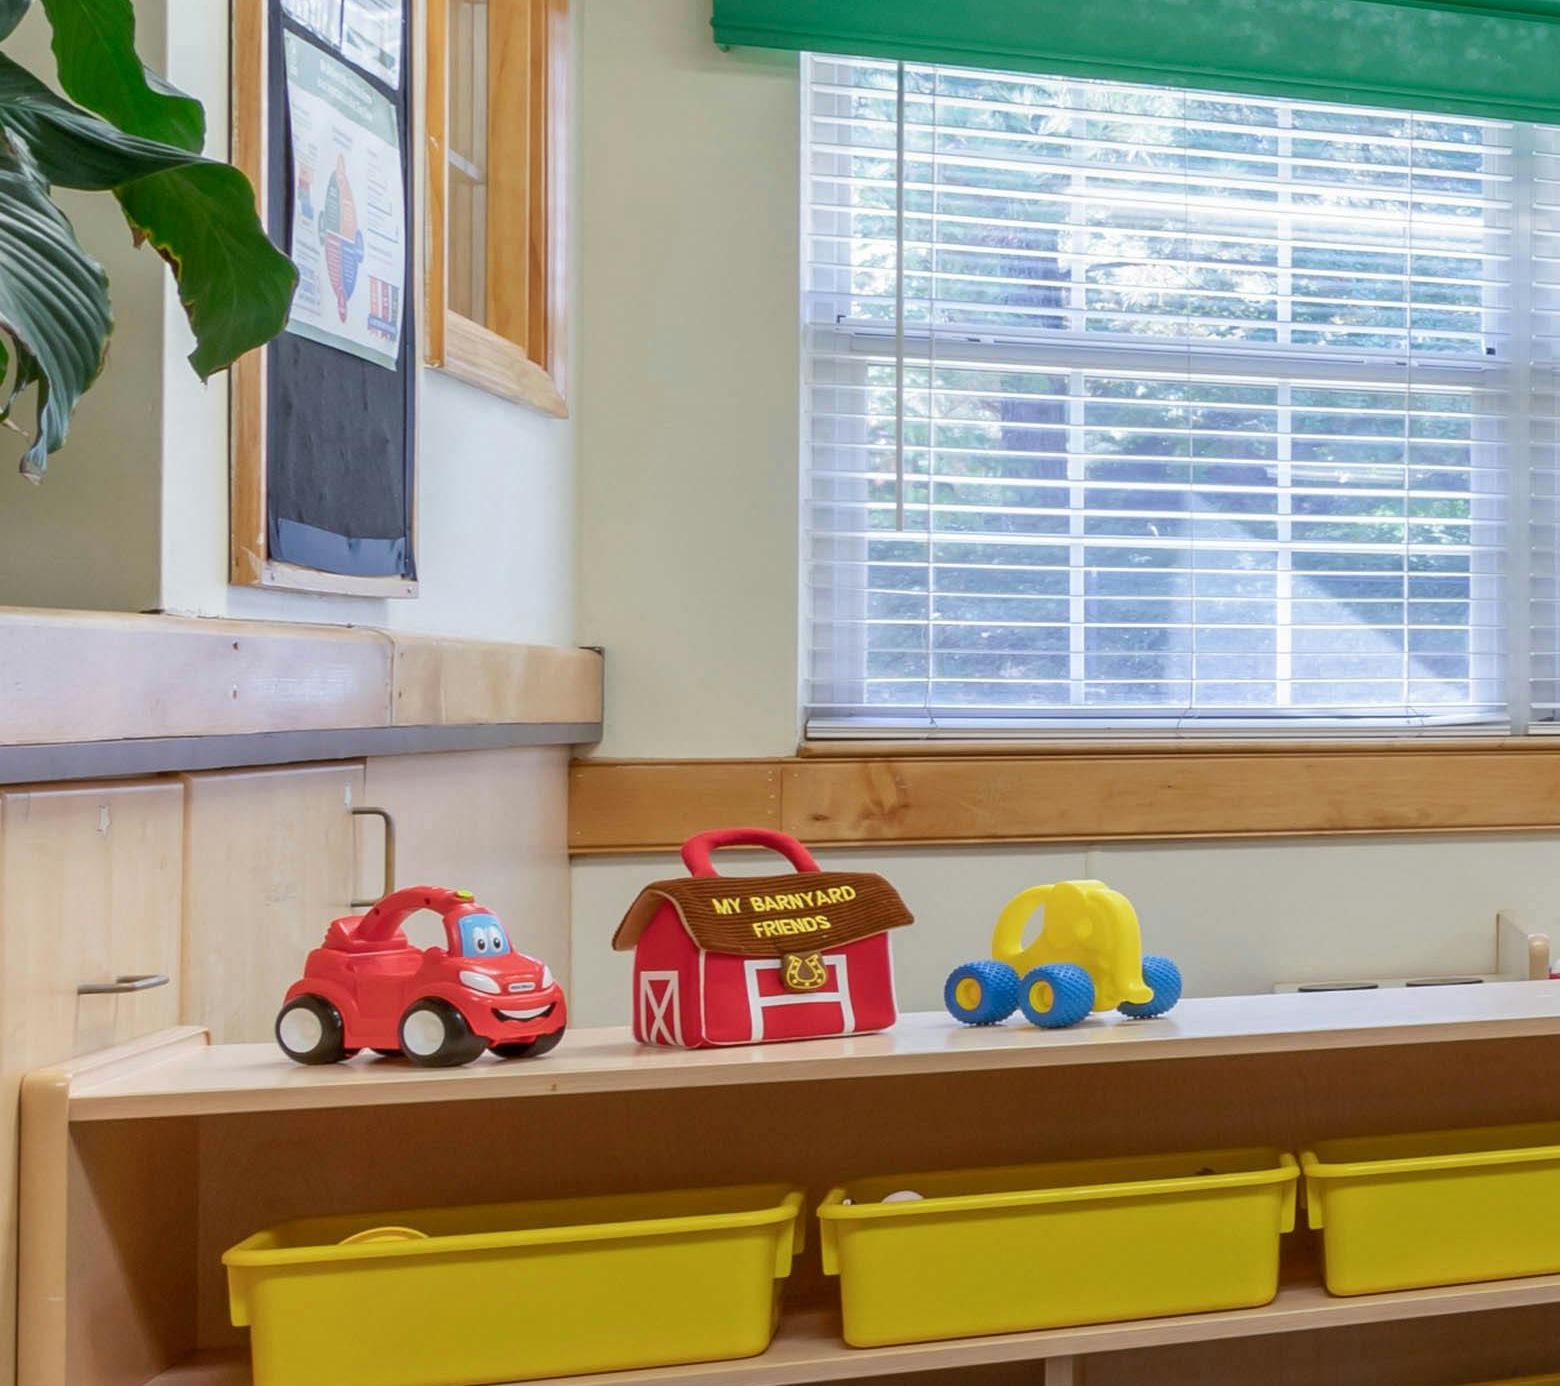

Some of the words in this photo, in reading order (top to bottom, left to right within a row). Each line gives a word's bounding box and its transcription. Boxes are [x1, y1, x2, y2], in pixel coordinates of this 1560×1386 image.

[712, 898, 741, 915] MY
[750, 885, 857, 912] BARNYARD
[752, 915, 832, 938] FRIENDS
